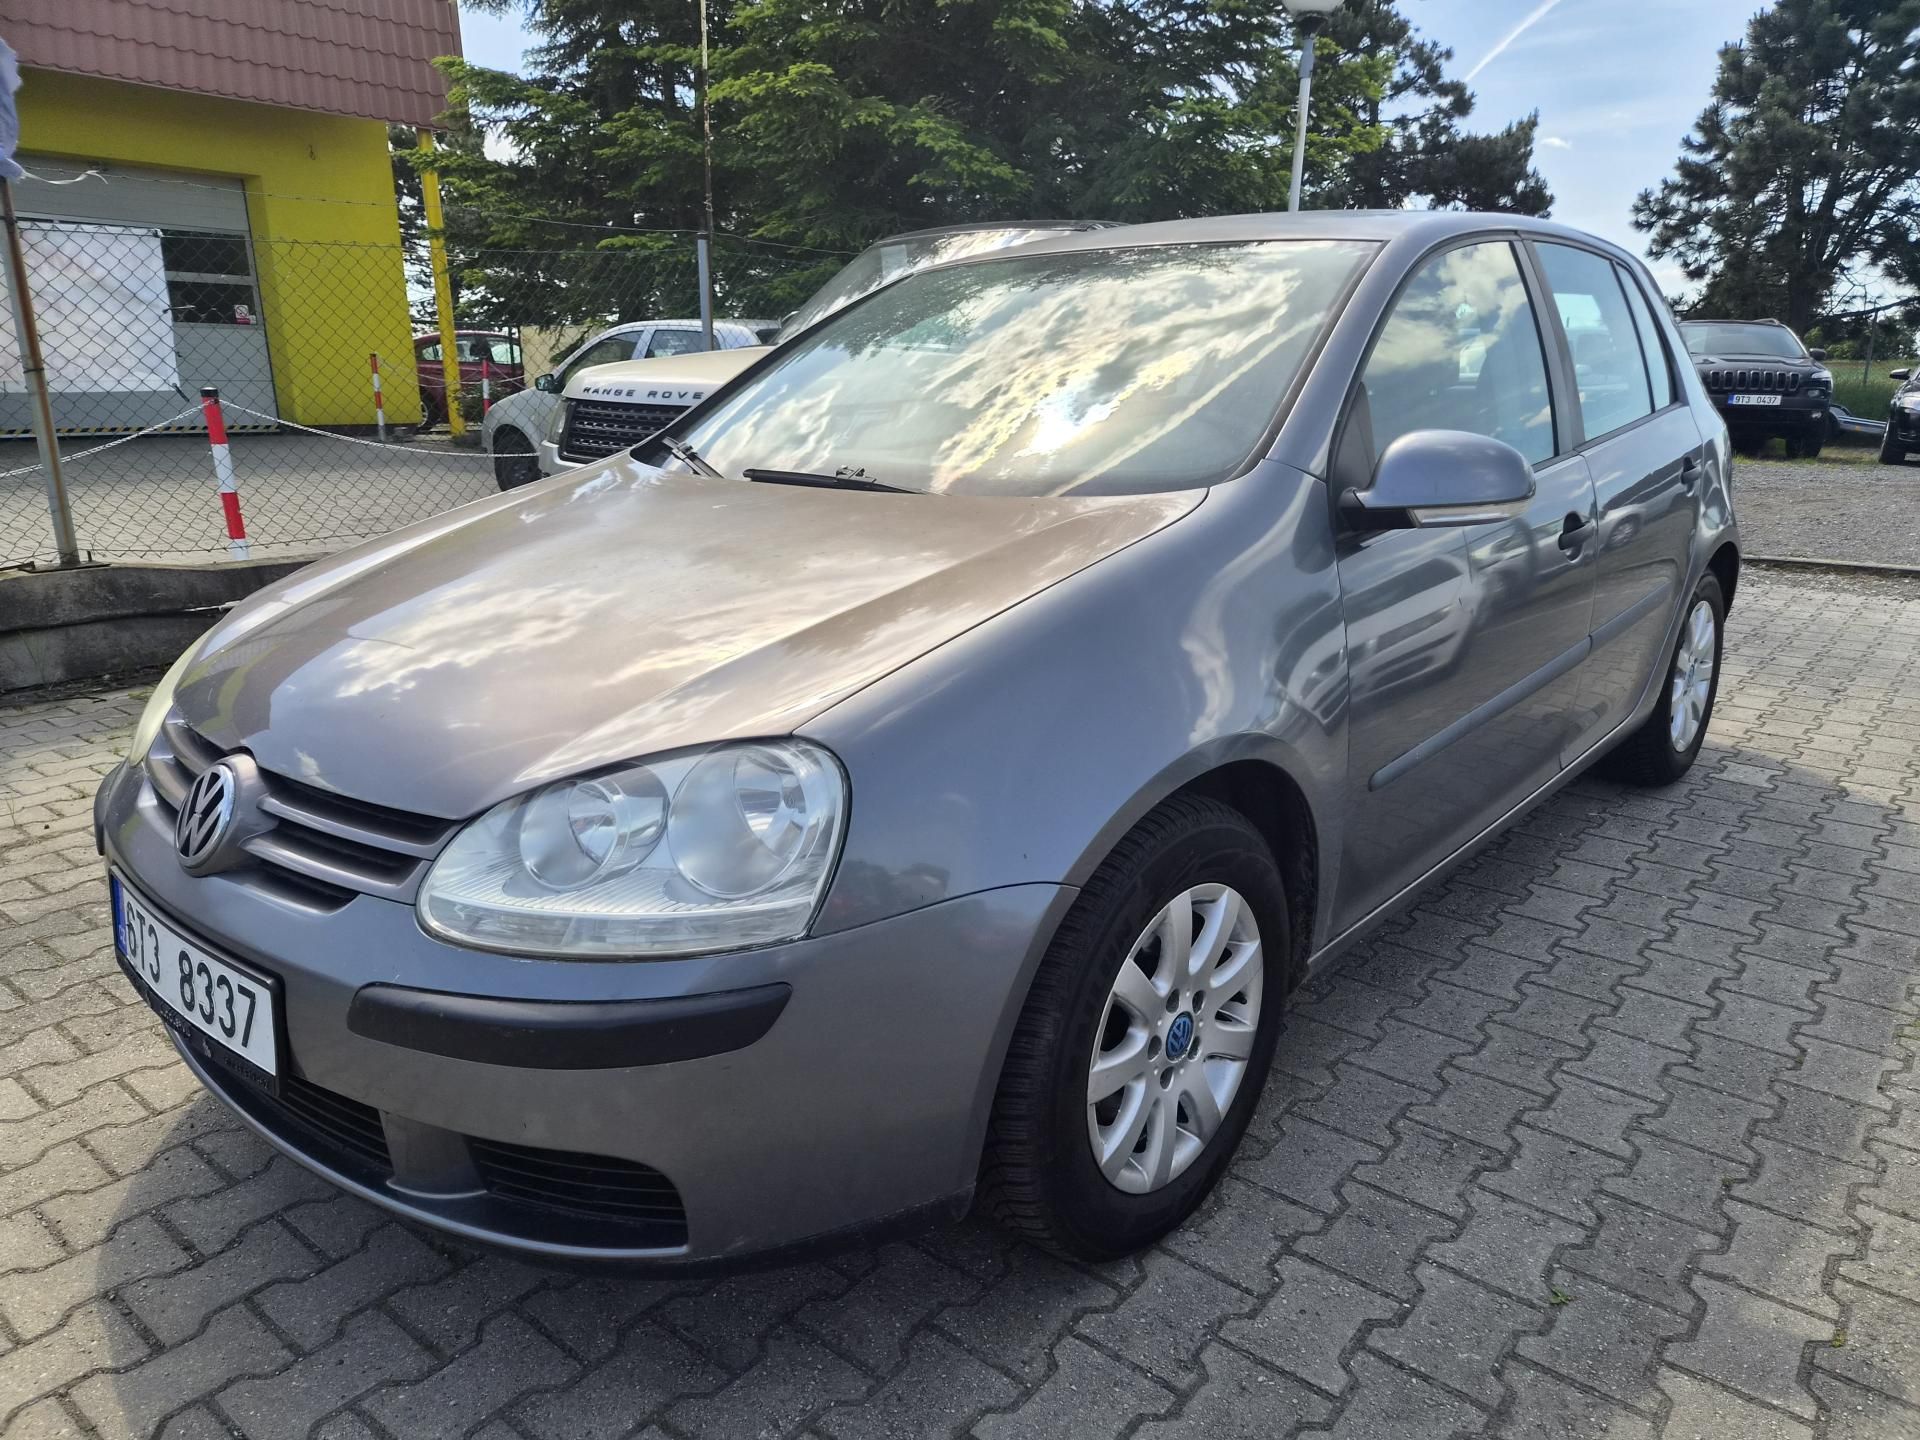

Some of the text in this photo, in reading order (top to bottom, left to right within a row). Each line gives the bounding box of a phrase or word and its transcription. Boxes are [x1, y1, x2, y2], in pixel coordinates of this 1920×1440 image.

[583, 386, 705, 400] RANGE ROVE
[1735, 395, 1777, 405] 9T3 0437
[175, 763, 236, 860] VW
[127, 901, 160, 984] 6T3
[178, 949, 256, 1049] 8337
